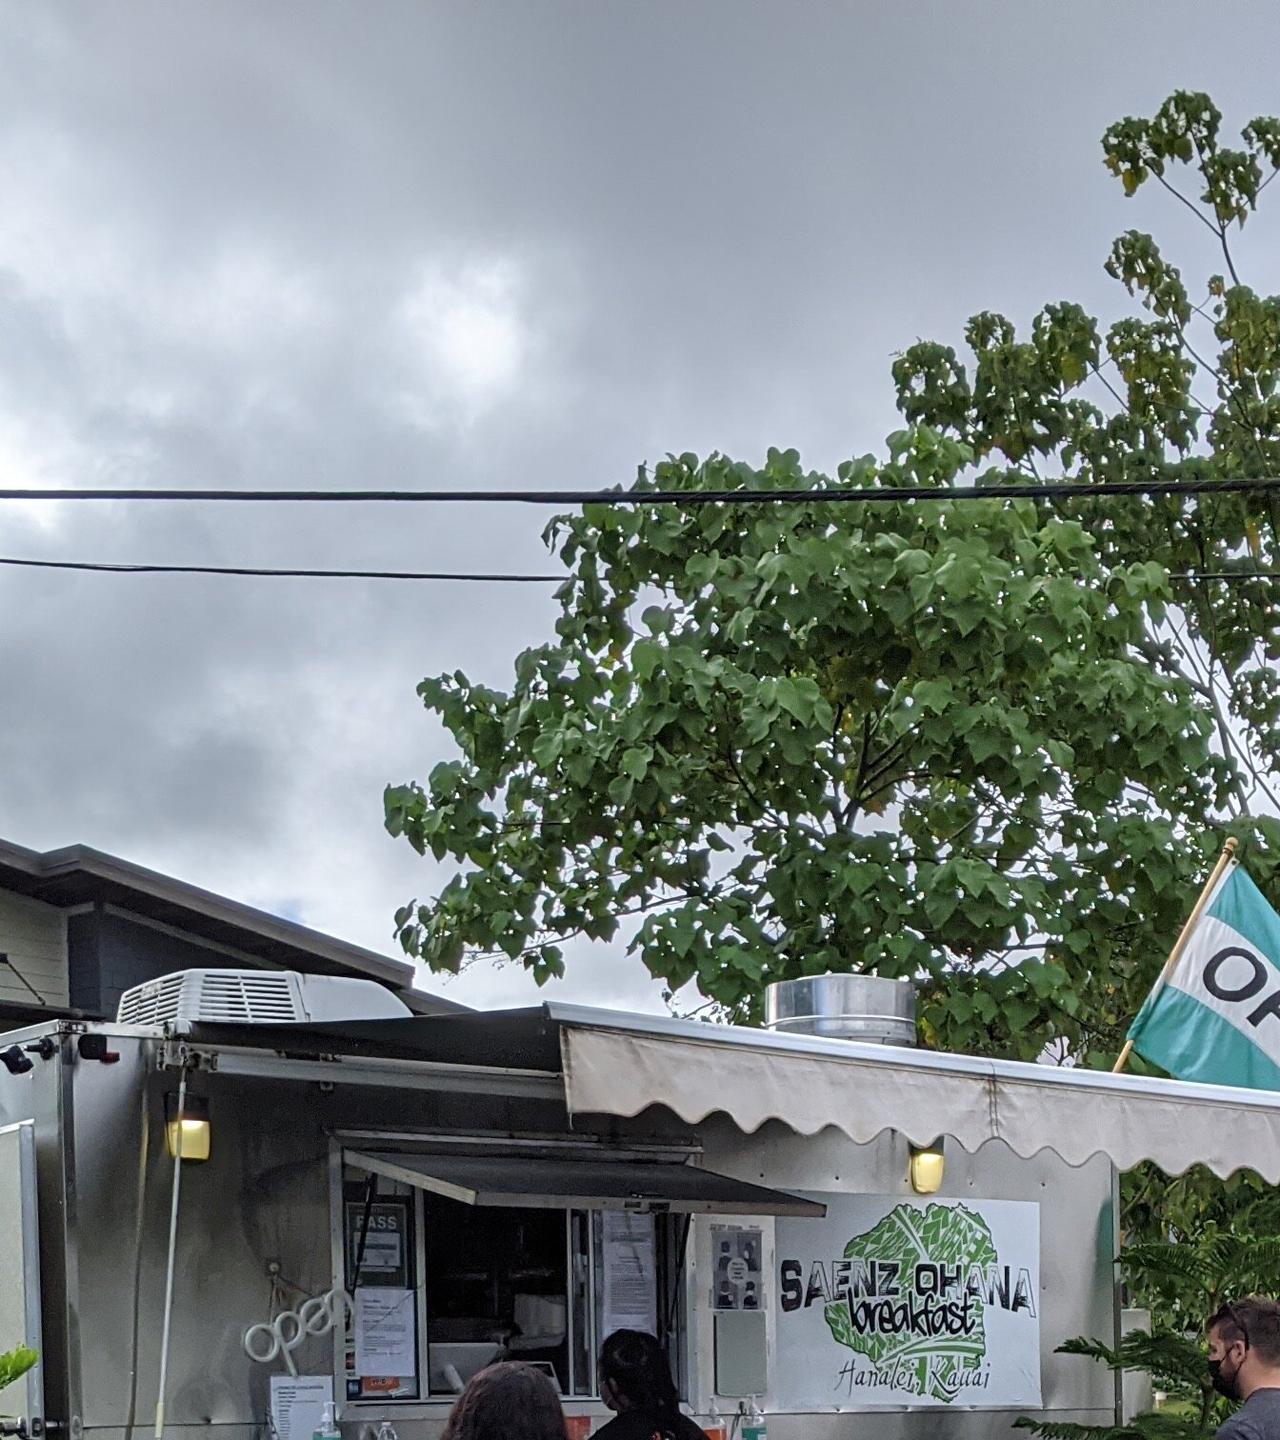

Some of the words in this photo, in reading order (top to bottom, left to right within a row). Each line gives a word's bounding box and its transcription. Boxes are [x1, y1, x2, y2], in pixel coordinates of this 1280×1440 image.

[781, 1260, 901, 1312] SAENZ
[915, 1263, 1037, 1319] OHANA
[848, 1287, 976, 1337] breakfast
[244, 1289, 355, 1377] open
[834, 1355, 921, 1397] Hanalei,
[928, 1359, 992, 1396] Kauai
